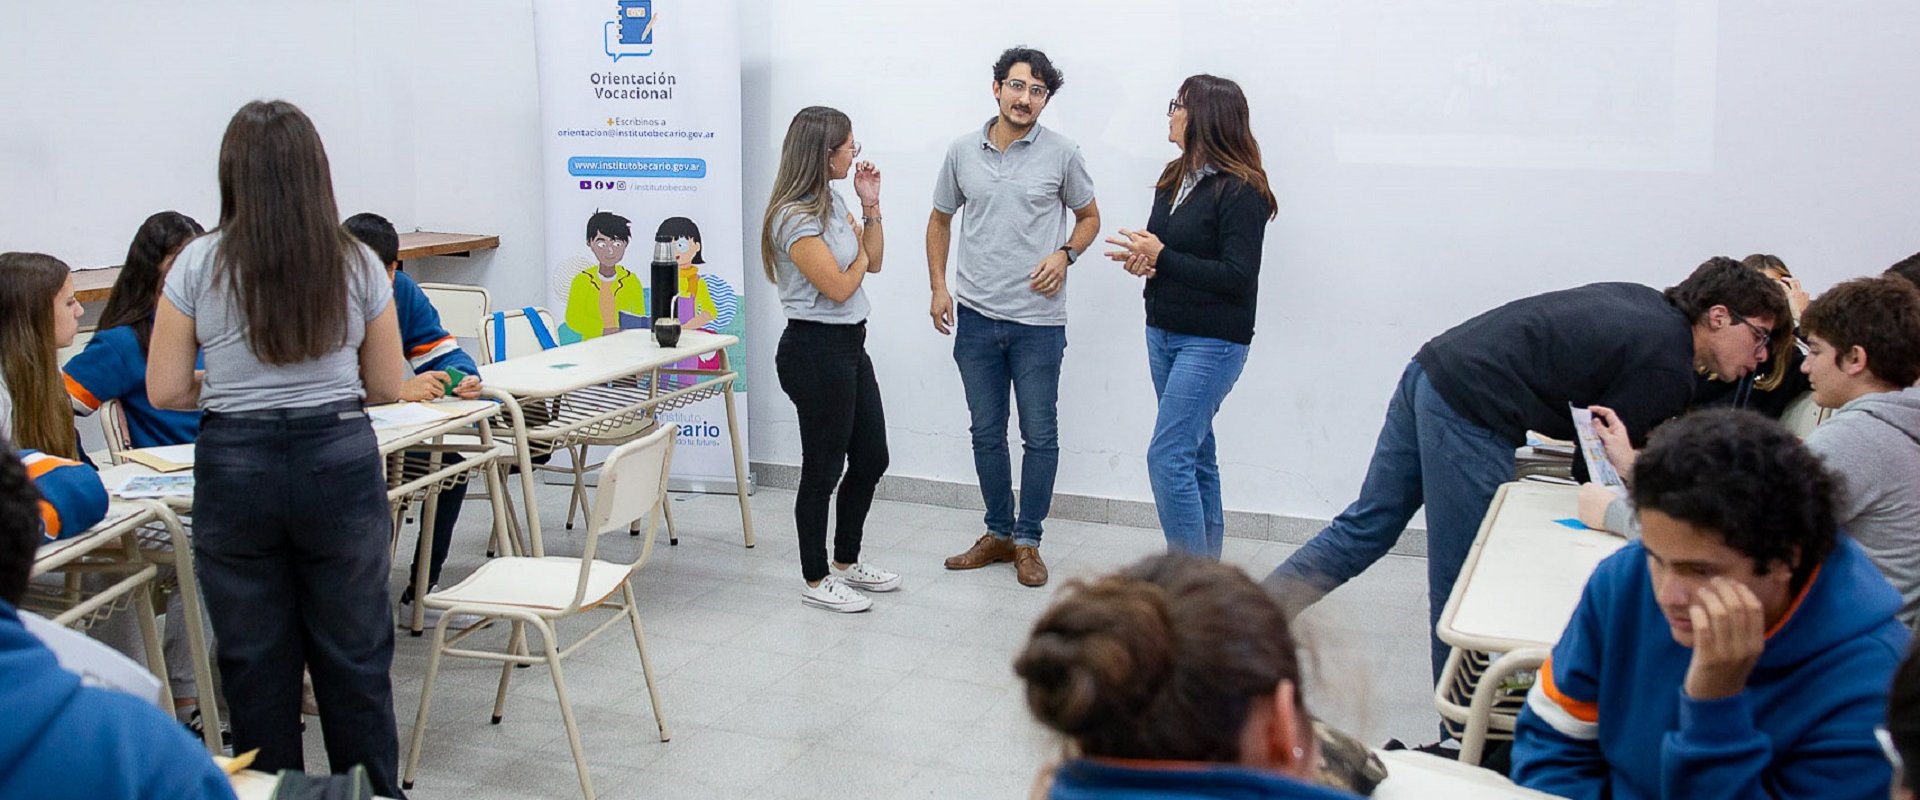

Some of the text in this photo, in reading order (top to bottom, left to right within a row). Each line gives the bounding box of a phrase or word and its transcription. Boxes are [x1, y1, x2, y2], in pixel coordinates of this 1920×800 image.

[590, 72, 676, 85] Orientación
[595, 87, 672, 100] Vocacional
[616, 117, 666, 126] Escribinos a
[558, 130, 714, 140] orientacion@institutobecario.gov.ar
[574, 160, 700, 172] www.institutobecario.gov.ar
